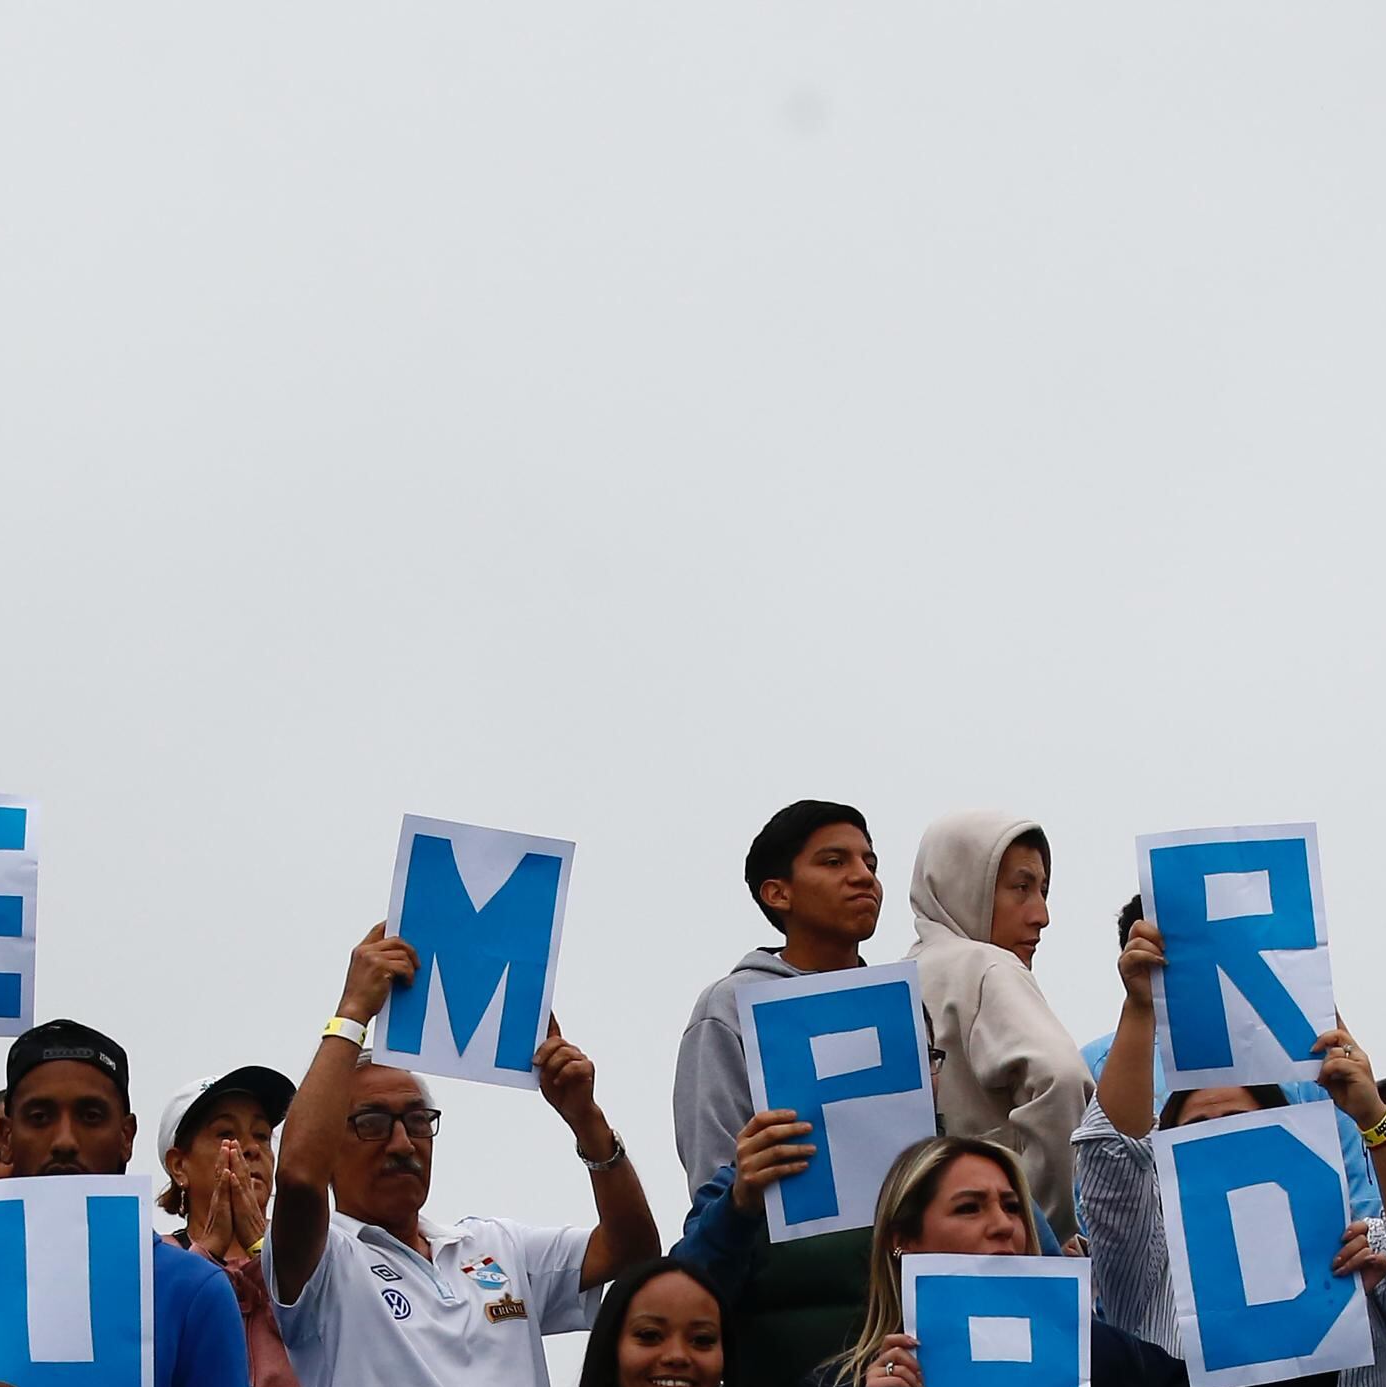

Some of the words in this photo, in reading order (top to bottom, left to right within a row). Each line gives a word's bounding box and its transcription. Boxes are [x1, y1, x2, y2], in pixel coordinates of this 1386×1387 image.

[386, 833, 563, 1072] M
[1150, 836, 1325, 1071] R
[752, 980, 922, 1224] P
[1173, 1124, 1357, 1372] D
